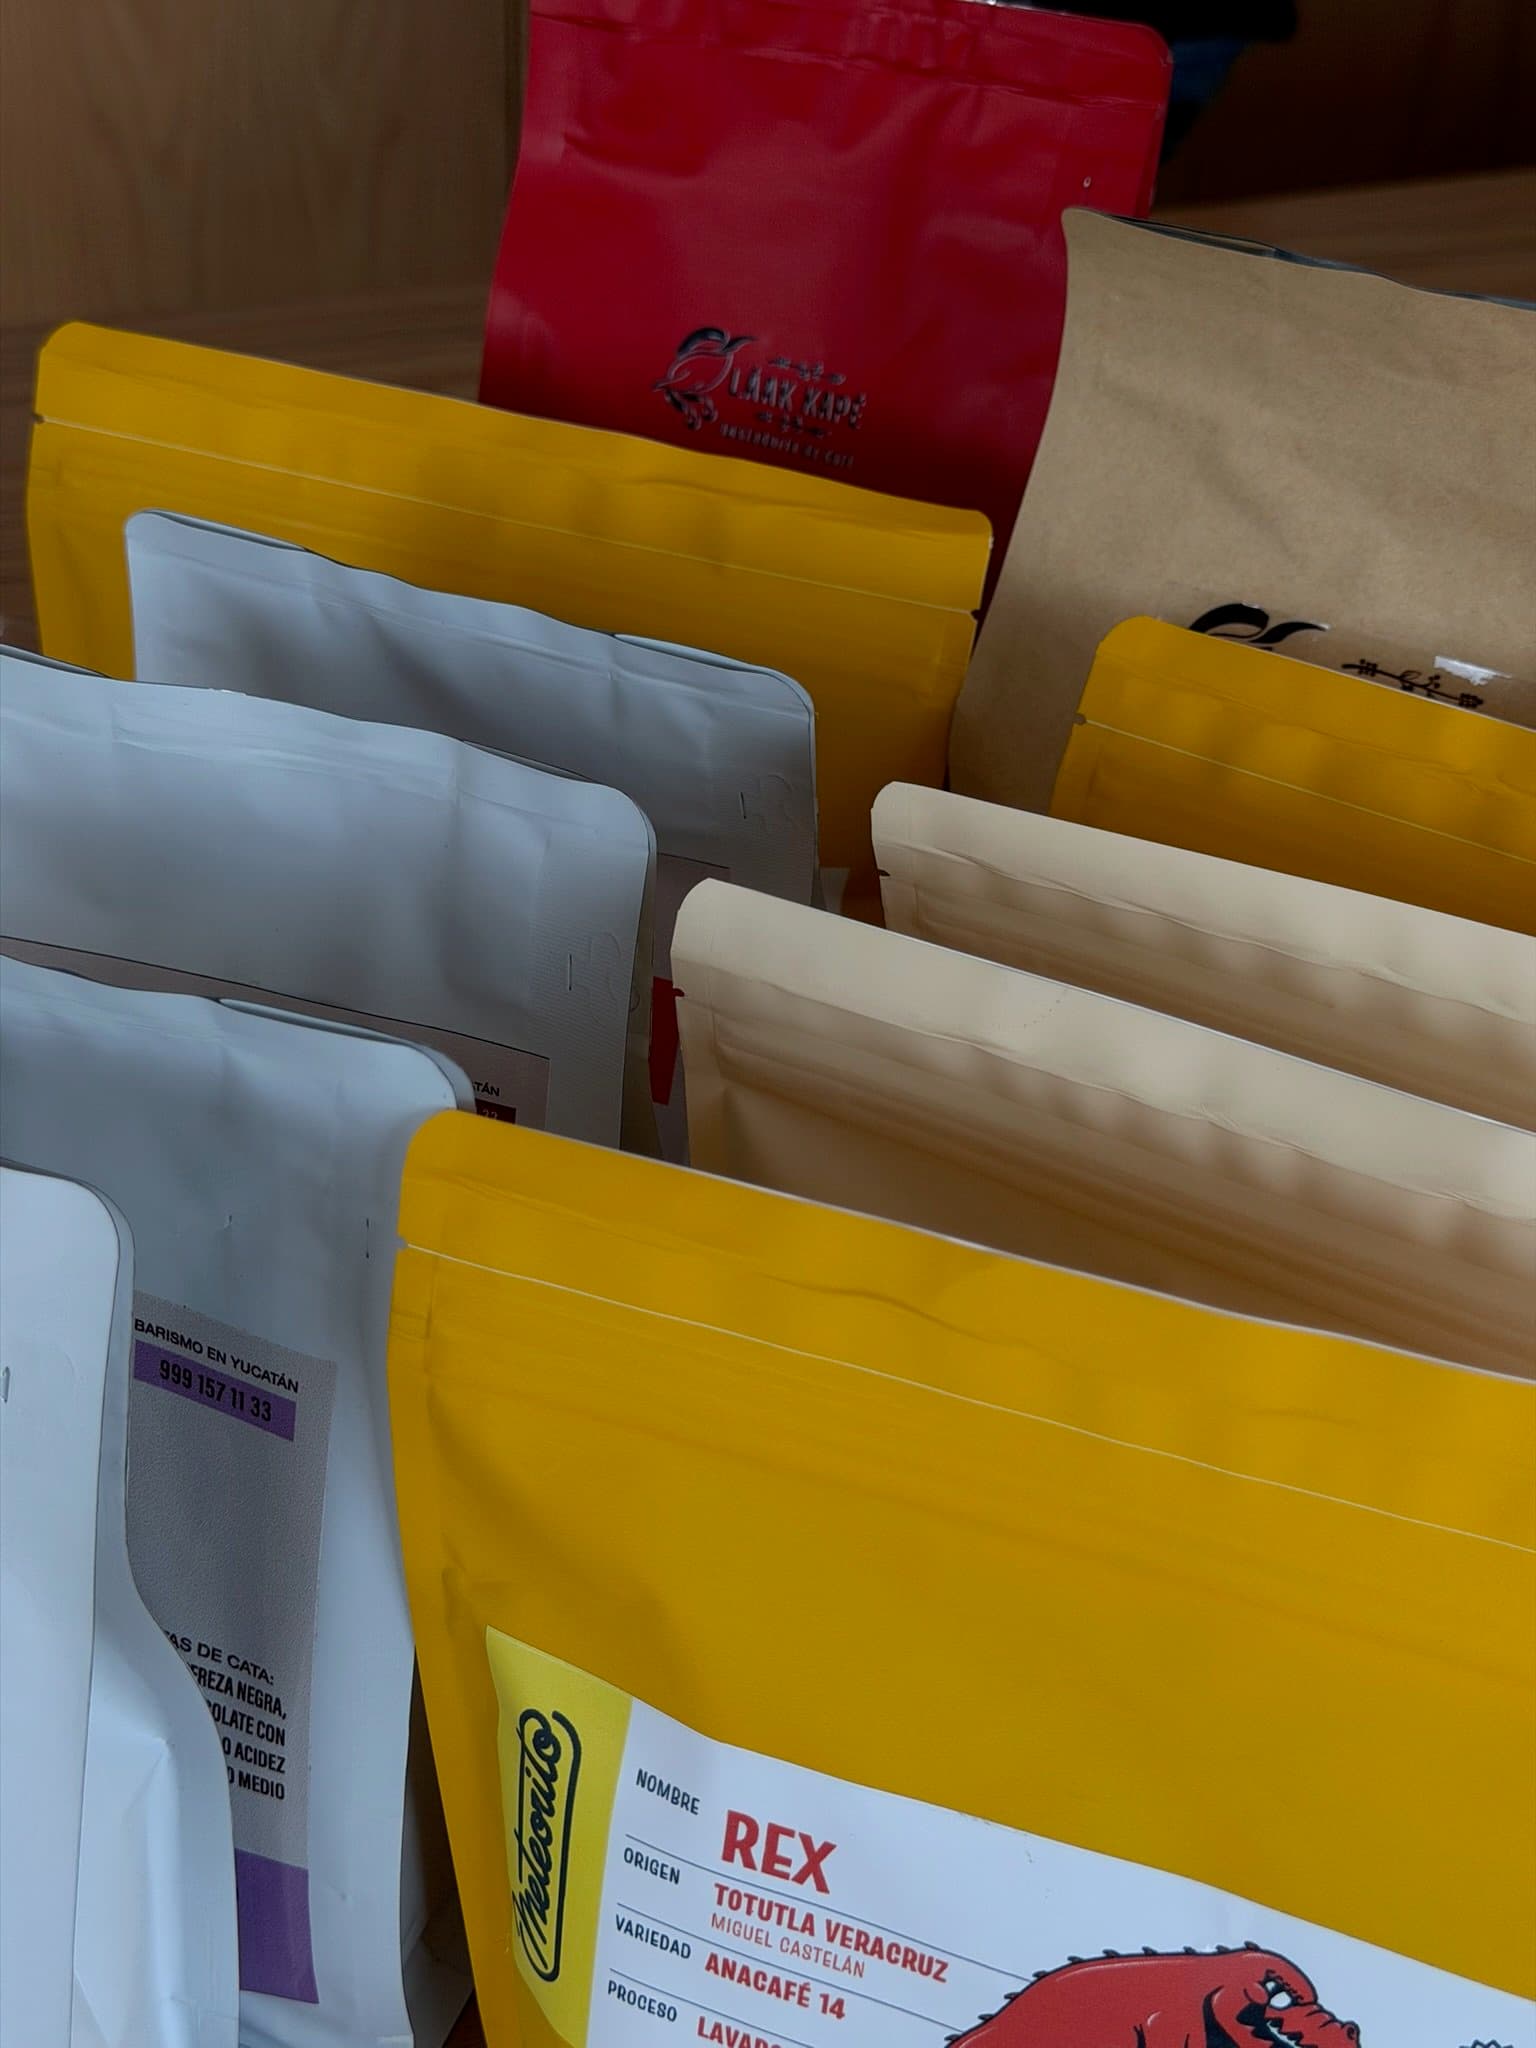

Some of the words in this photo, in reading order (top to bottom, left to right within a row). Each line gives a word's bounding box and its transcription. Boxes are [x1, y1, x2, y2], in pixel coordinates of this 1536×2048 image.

[134, 1318, 204, 1354] BARISMO
[207, 1346, 227, 1365] EN
[230, 1355, 299, 1393] YUCATÁN
[159, 1359, 193, 1389] 999
[197, 1374, 226, 1402] 157
[230, 1387, 244, 1411] 11
[250, 1396, 272, 1422] 33
[164, 1630, 192, 1653] AS
[197, 1641, 223, 1663] DE
[227, 1654, 274, 1686] CATA:
[236, 1679, 287, 1720] NEGRA,
[234, 1742, 287, 1774] ACIDEZ
[256, 1719, 286, 1747] CON
[238, 1770, 285, 1801] MEDIO
[636, 1768, 701, 1816] NOMBRE
[721, 1809, 838, 1895] REX
[623, 1847, 681, 1885] ORIGEN
[714, 1882, 817, 1937] TOTUTLA
[825, 1917, 950, 1983] VERACRUZ
[615, 1914, 692, 1960] VARIEDAD
[704, 1951, 812, 2008] ANACAFÉ
[819, 1992, 847, 2020] 14
[710, 1912, 773, 1949] MIGUEL
[780, 1937, 866, 1978] CASTELÁN
[607, 1979, 678, 2023] PROCESO
